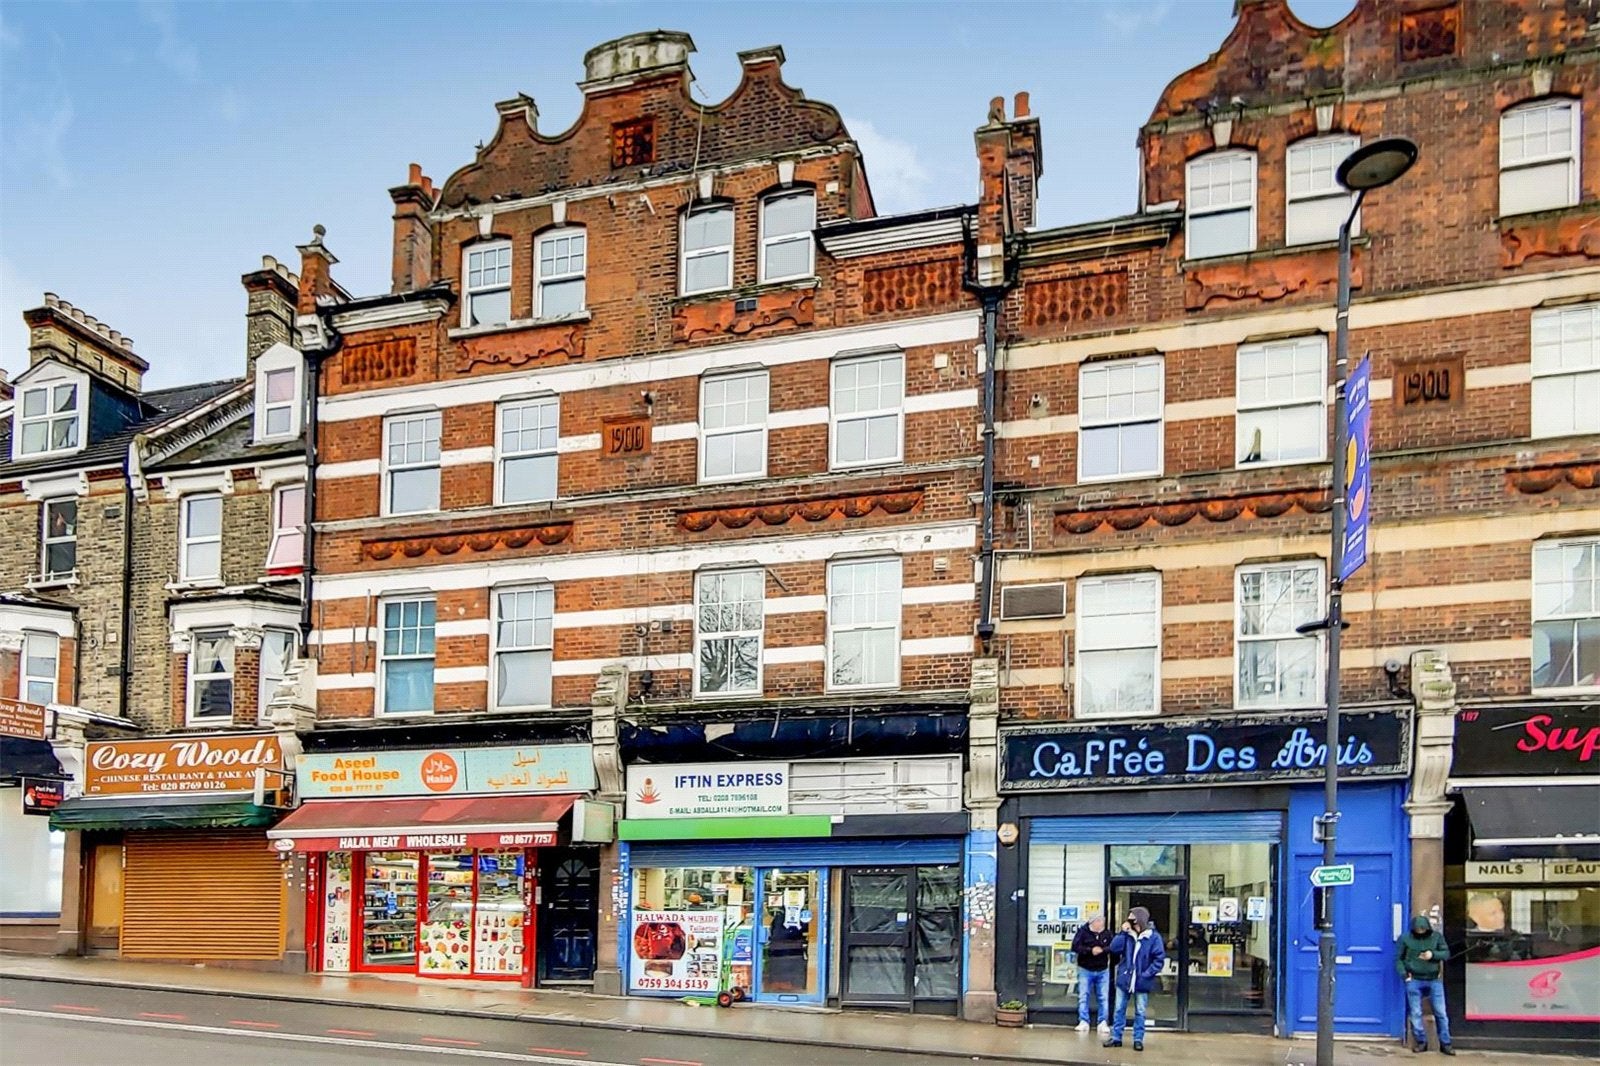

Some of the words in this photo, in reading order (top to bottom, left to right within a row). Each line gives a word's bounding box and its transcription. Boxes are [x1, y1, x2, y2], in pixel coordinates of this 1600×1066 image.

[1404, 369, 1450, 404] 1900
[611, 425, 644, 453] 1900
[16, 704, 42, 716] Woods
[92, 745, 168, 773] Cozy
[169, 739, 279, 767] Woods
[1186, 734, 1256, 772] Des
[334, 757, 376, 769] Aseel
[425, 758, 452, 774] حلال
[100, 774, 141, 783] CHINESE
[143, 771, 205, 782] RESTAURANT
[206, 771, 215, 780] &
[217, 770, 242, 779] TAKE
[312, 771, 347, 782] Food
[352, 769, 400, 781] House
[426, 774, 454, 784] Halal
[675, 775, 712, 788] IFTIN
[717, 773, 783, 787] EXPRESS
[142, 783, 160, 792] Tel:
[160, 782, 178, 791] 020
[179, 781, 202, 791] 8769
[203, 780, 227, 789] 0126
[339, 836, 372, 849] HALAL
[372, 836, 400, 848] MEAT
[406, 834, 468, 847] WHOLESALE
[499, 834, 515, 845] 020
[534, 833, 553, 844] 7757
[1478, 864, 1524, 875] NAILS
[636, 913, 685, 922] HALWADA
[638, 978, 662, 989] 0759
[665, 979, 682, 989] 304
[685, 979, 709, 989] 5139
